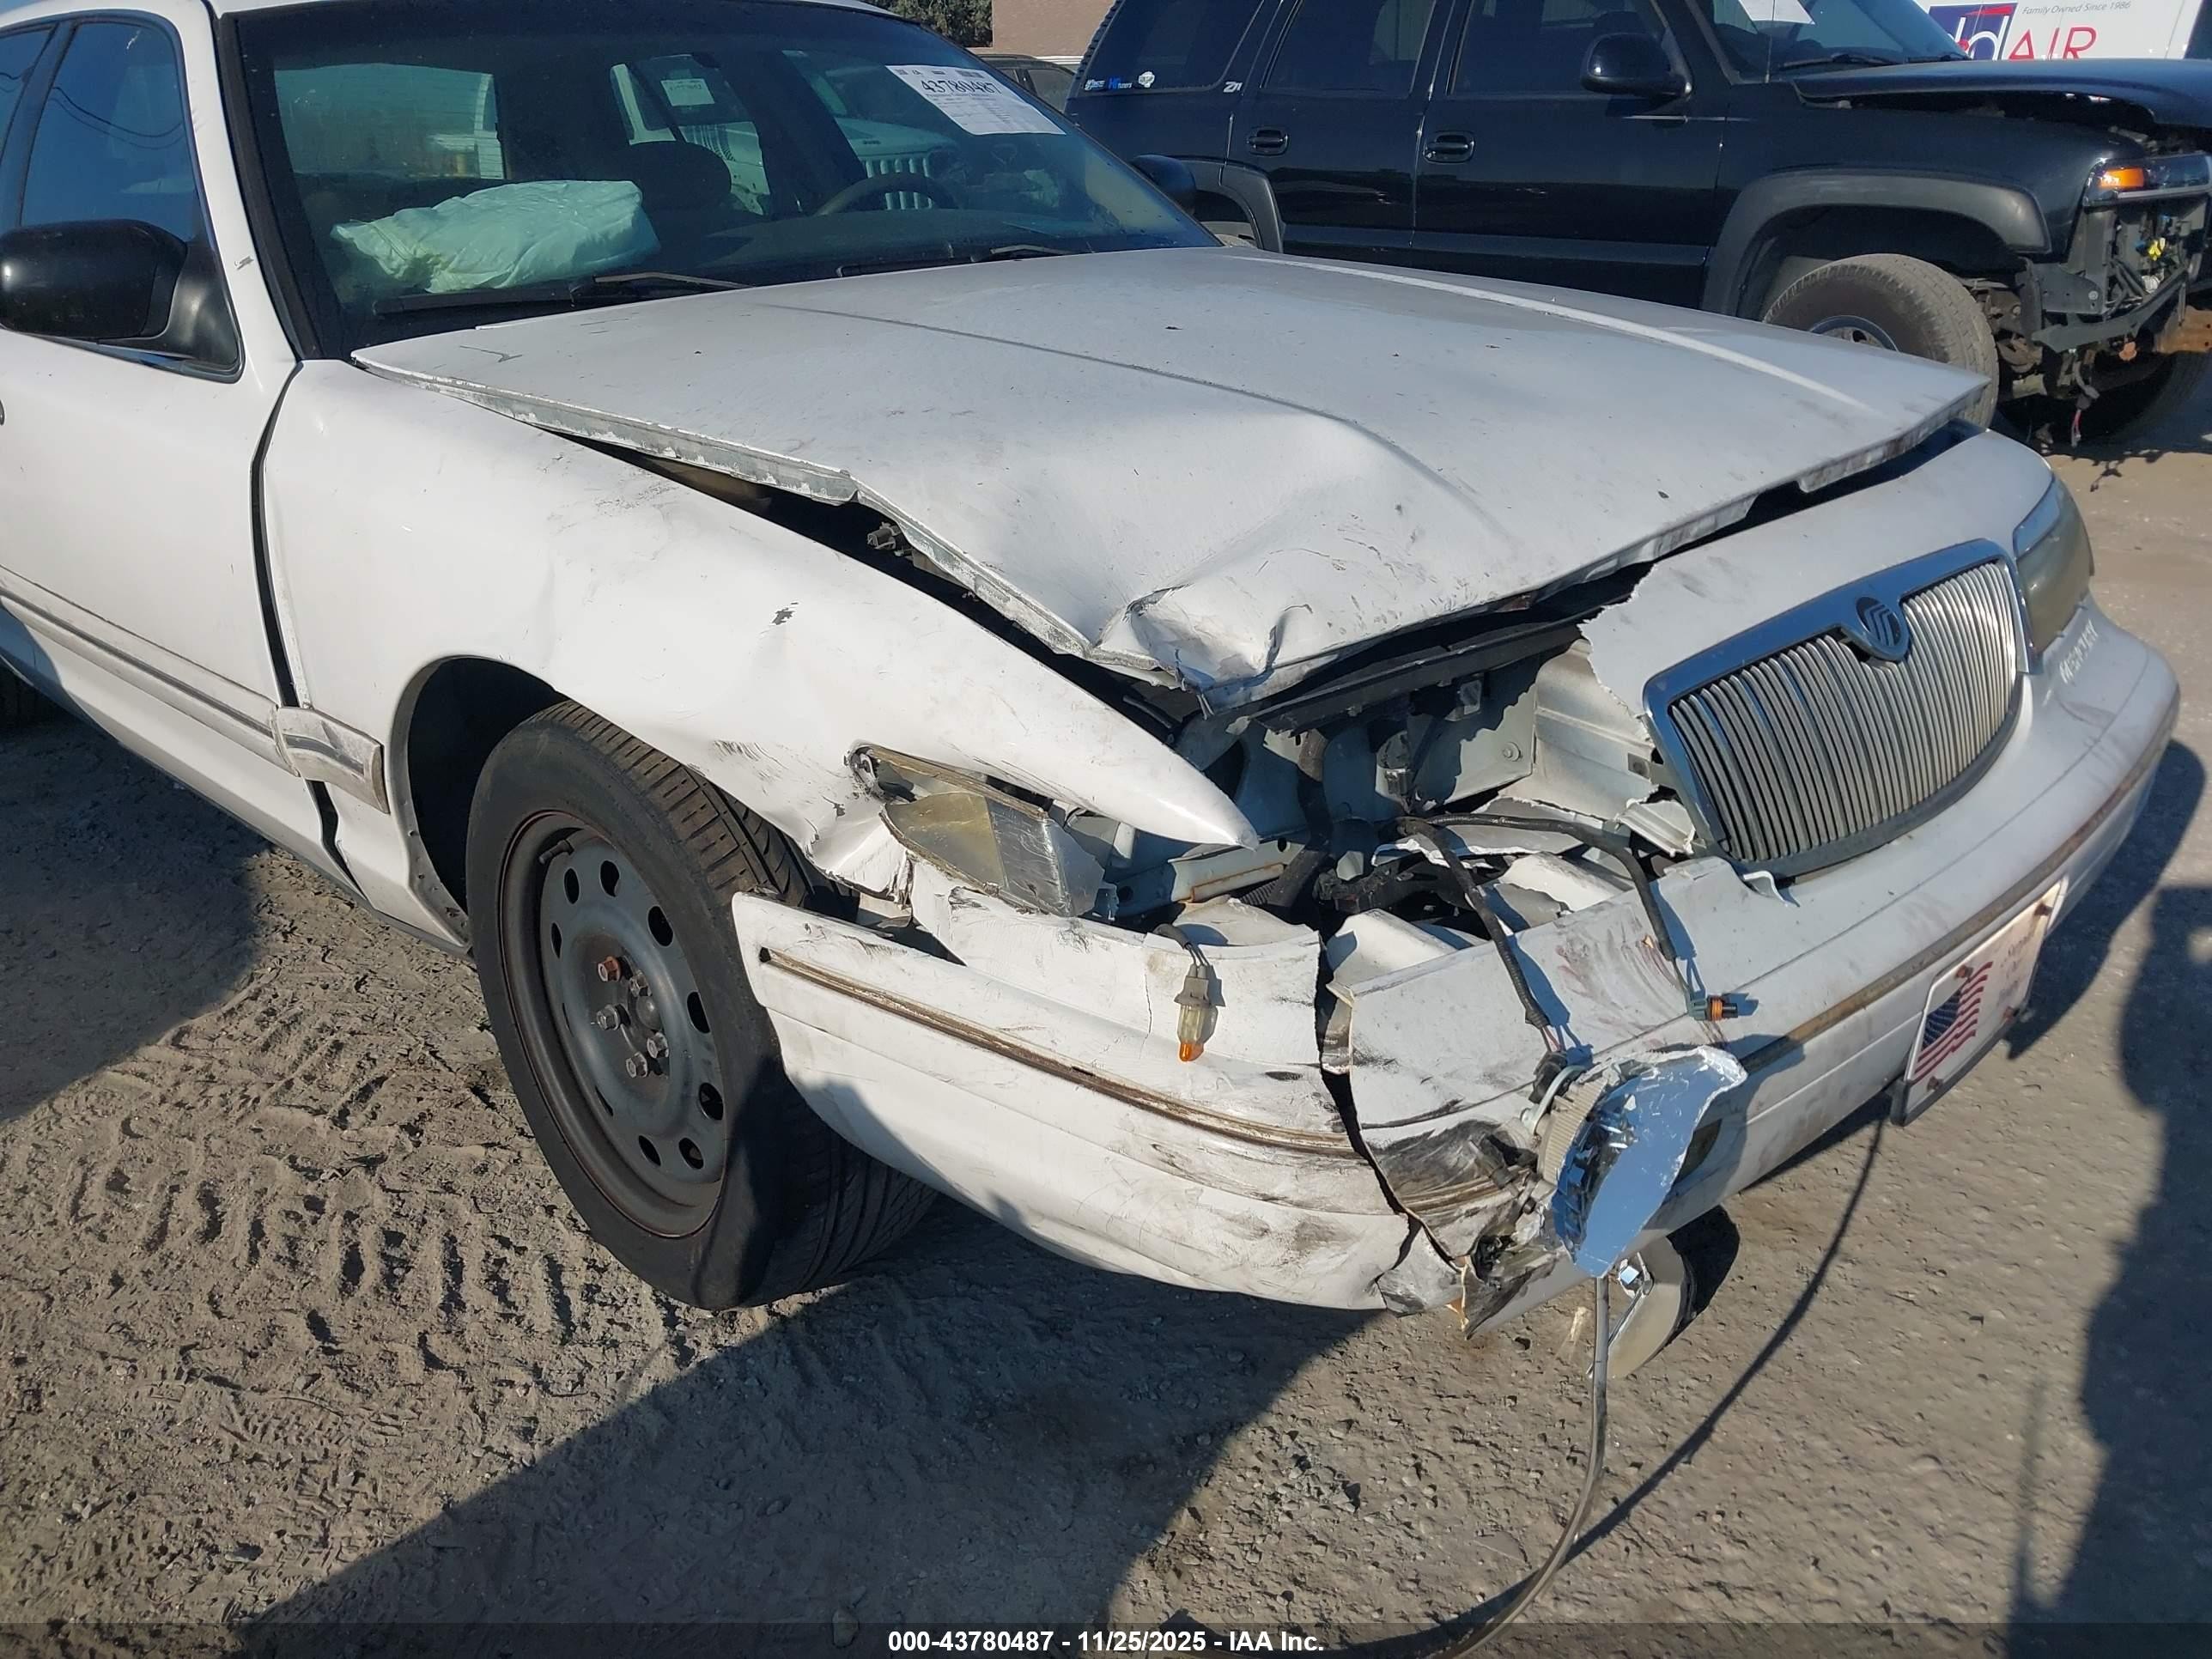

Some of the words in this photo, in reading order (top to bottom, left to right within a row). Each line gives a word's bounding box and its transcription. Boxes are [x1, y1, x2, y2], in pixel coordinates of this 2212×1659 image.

[2021, 6, 2050, 15] Family
[2051, 4, 2081, 13] Owned
[2084, 3, 2107, 11] Since
[2110, 1, 2131, 9] 1986
[2008, 27, 2097, 59] AIR
[921, 80, 1002, 94] 43780487
